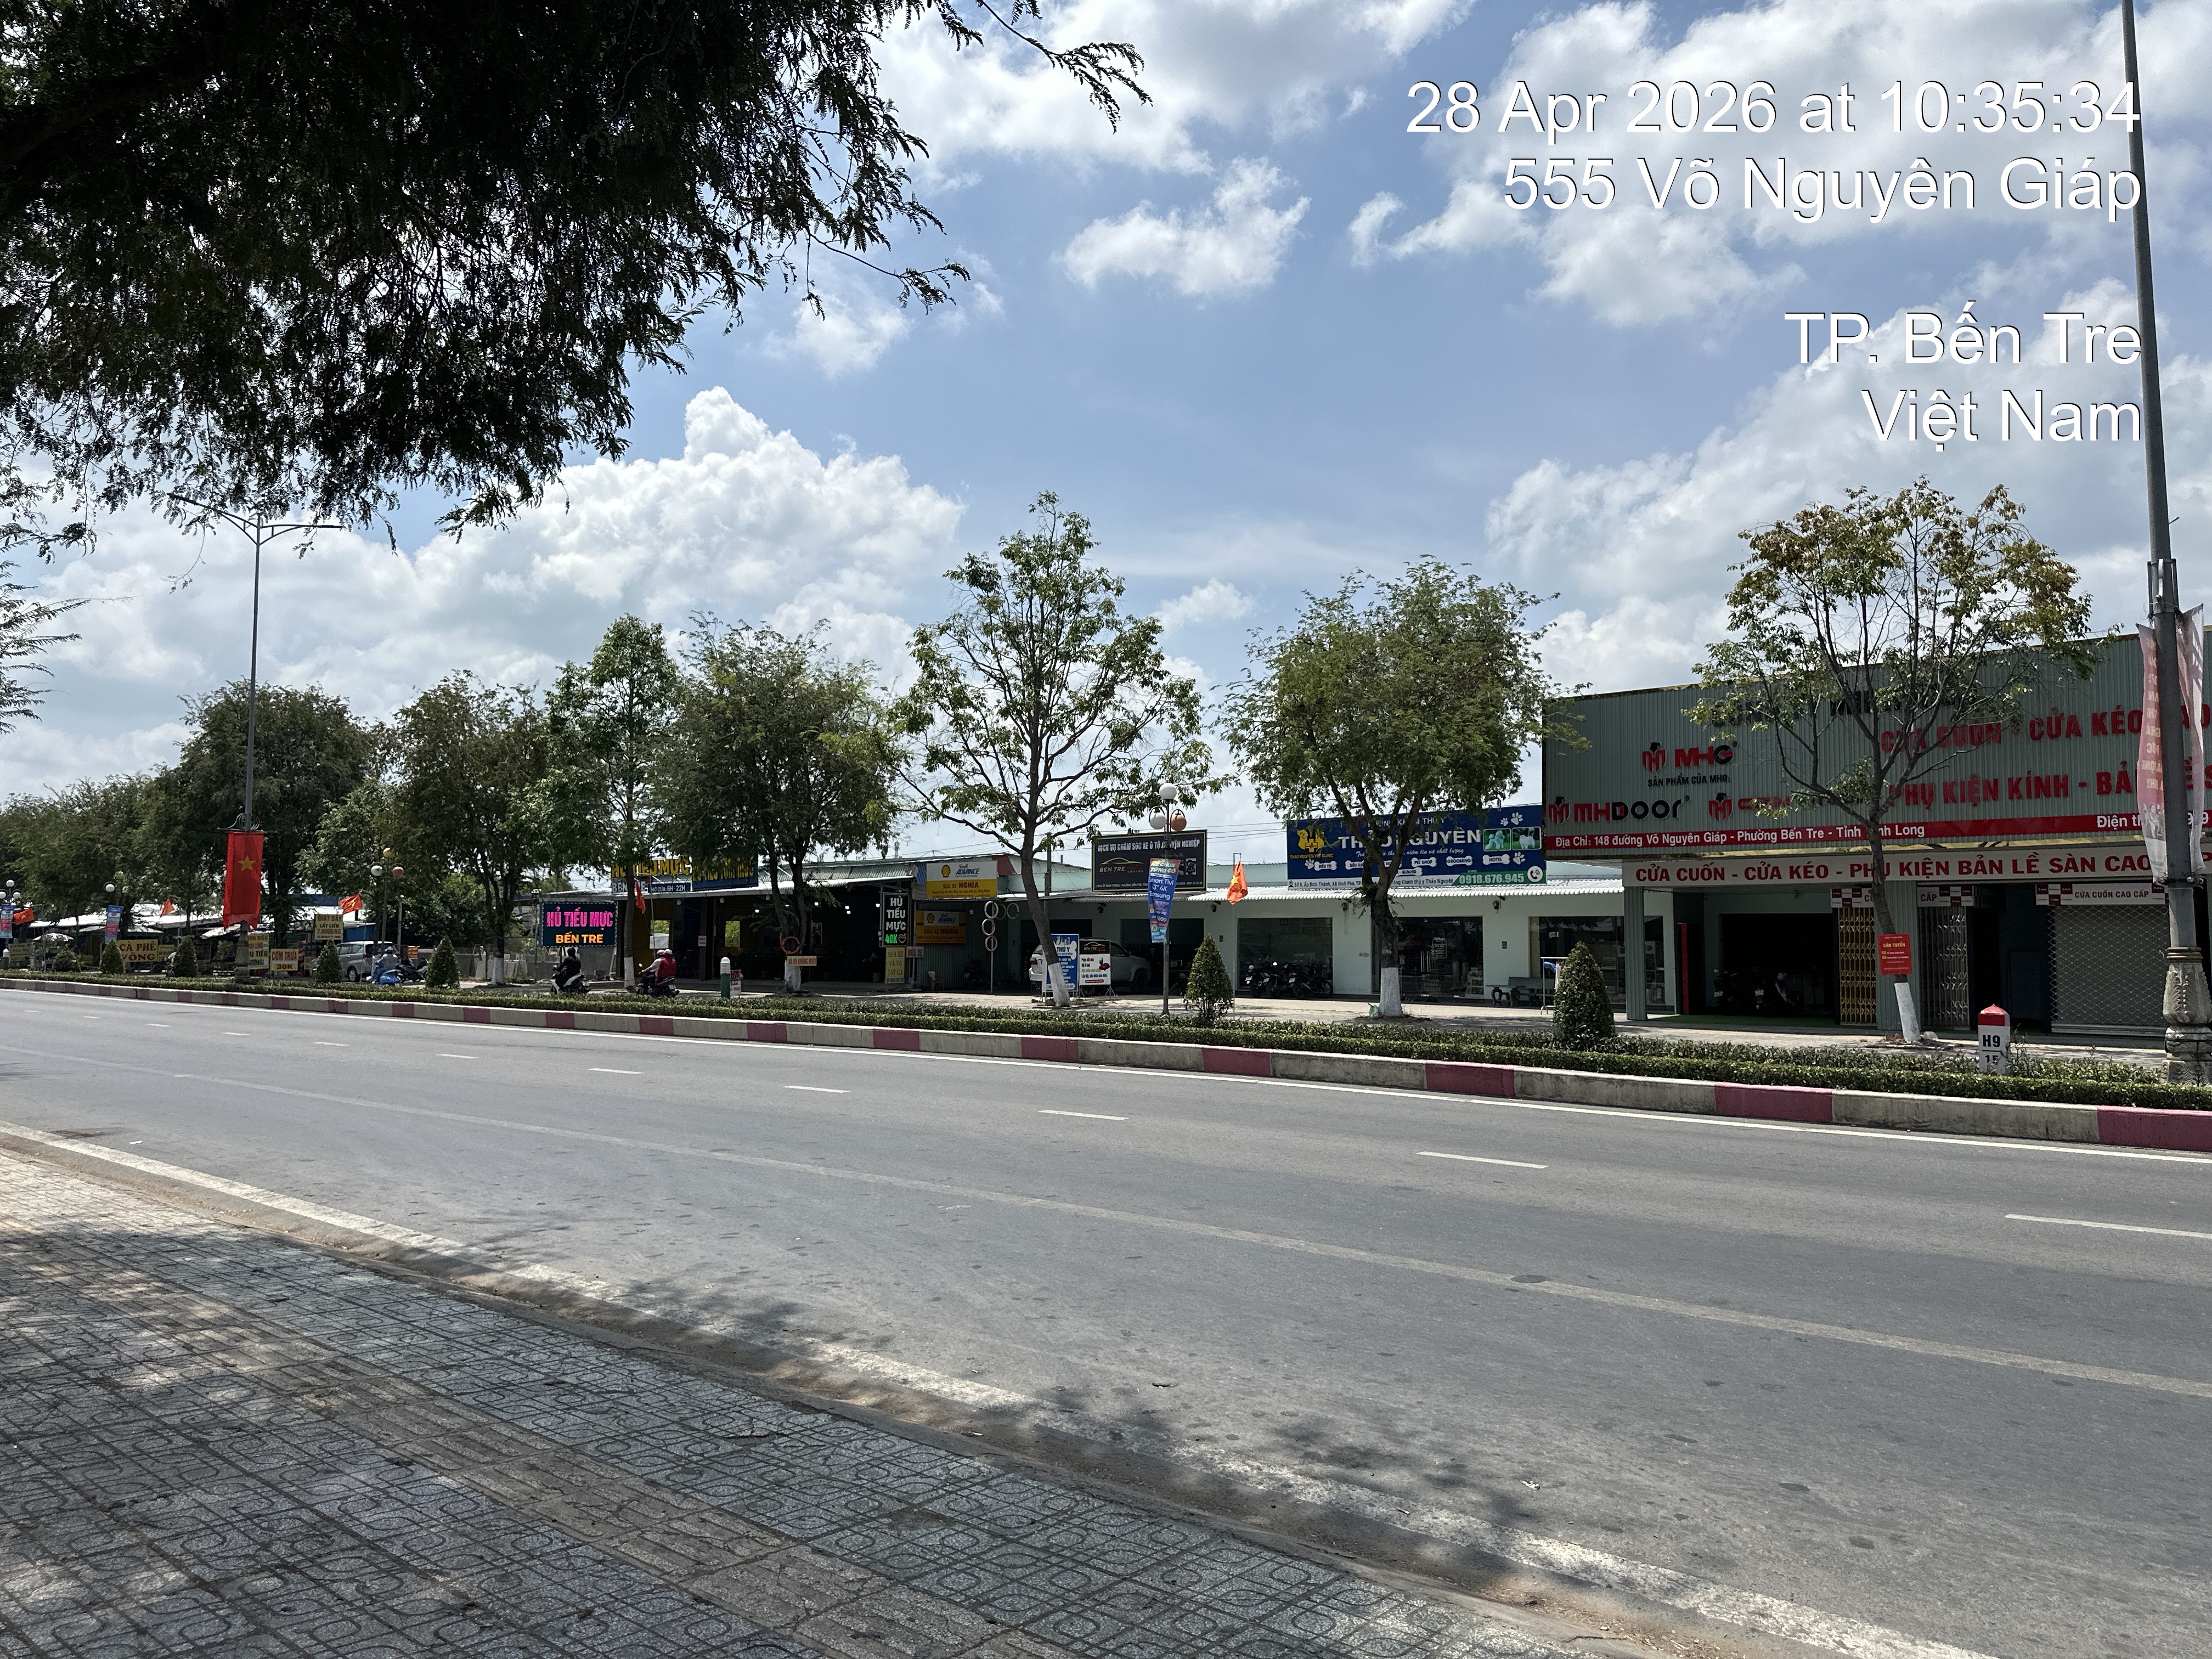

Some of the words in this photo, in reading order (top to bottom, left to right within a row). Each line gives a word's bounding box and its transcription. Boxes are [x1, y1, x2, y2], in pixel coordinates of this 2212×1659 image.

[2029, 707, 2082, 741] CỬA
[2091, 705, 2142, 736] KÉO
[1647, 775, 1664, 787] SẢN
[1666, 772, 1690, 786] PHẨM
[1692, 773, 1708, 785] CỦA
[1943, 774, 1999, 806] KIỆN
[2007, 770, 2069, 800] KÍNH
[2096, 760, 2138, 796] BẢ
[2096, 814, 2128, 830] Điện
[1555, 837, 1571, 849] Địa
[1573, 834, 1592, 847] Chỉ:
[1594, 836, 1610, 847] 148
[1612, 834, 1643, 848] đường
[1646, 833, 1659, 845] Võ
[1662, 832, 1701, 847] Nguyên
[1703, 830, 1728, 845] Giáp
[1737, 830, 1778, 844] Phường
[1780, 828, 1802, 840] Bến
[1805, 828, 1825, 839] Tre
[1836, 826, 1861, 838] Tỉnh
[1894, 825, 1925, 840] Long
[1143, 842, 1149, 850] XE
[1635, 863, 1671, 882] CỬA
[1675, 861, 1725, 881] CUỐN
[1743, 861, 1782, 880] CỬA
[1788, 860, 1829, 879] KÉO
[1899, 857, 1949, 879] KIỆN
[1957, 854, 2002, 876] BẢN
[2011, 854, 2039, 874] LỀ
[2049, 853, 2101, 873] SÀN
[2104, 855, 2151, 872] CAO
[1459, 873, 1525, 884] 0918.676.945
[1921, 891, 1937, 901] CẤP
[2092, 888, 2113, 898] CUỐN
[2133, 888, 2149, 898] CẤP
[890, 895, 903, 907] HỦ
[546, 906, 562, 927] HỦ
[564, 906, 588, 927] TIẾU
[589, 911, 613, 930] MỰC
[886, 907, 905, 918] TIẾU
[885, 921, 906, 932] MỰC
[555, 931, 579, 944] BẾN
[581, 934, 603, 943] TRE
[885, 934, 898, 944] 40K
[119, 940, 133, 952] CÀ
[136, 940, 156, 952] PHÊ
[1982, 1034, 2001, 1048] H9
[1985, 1054, 2000, 1065] 15
